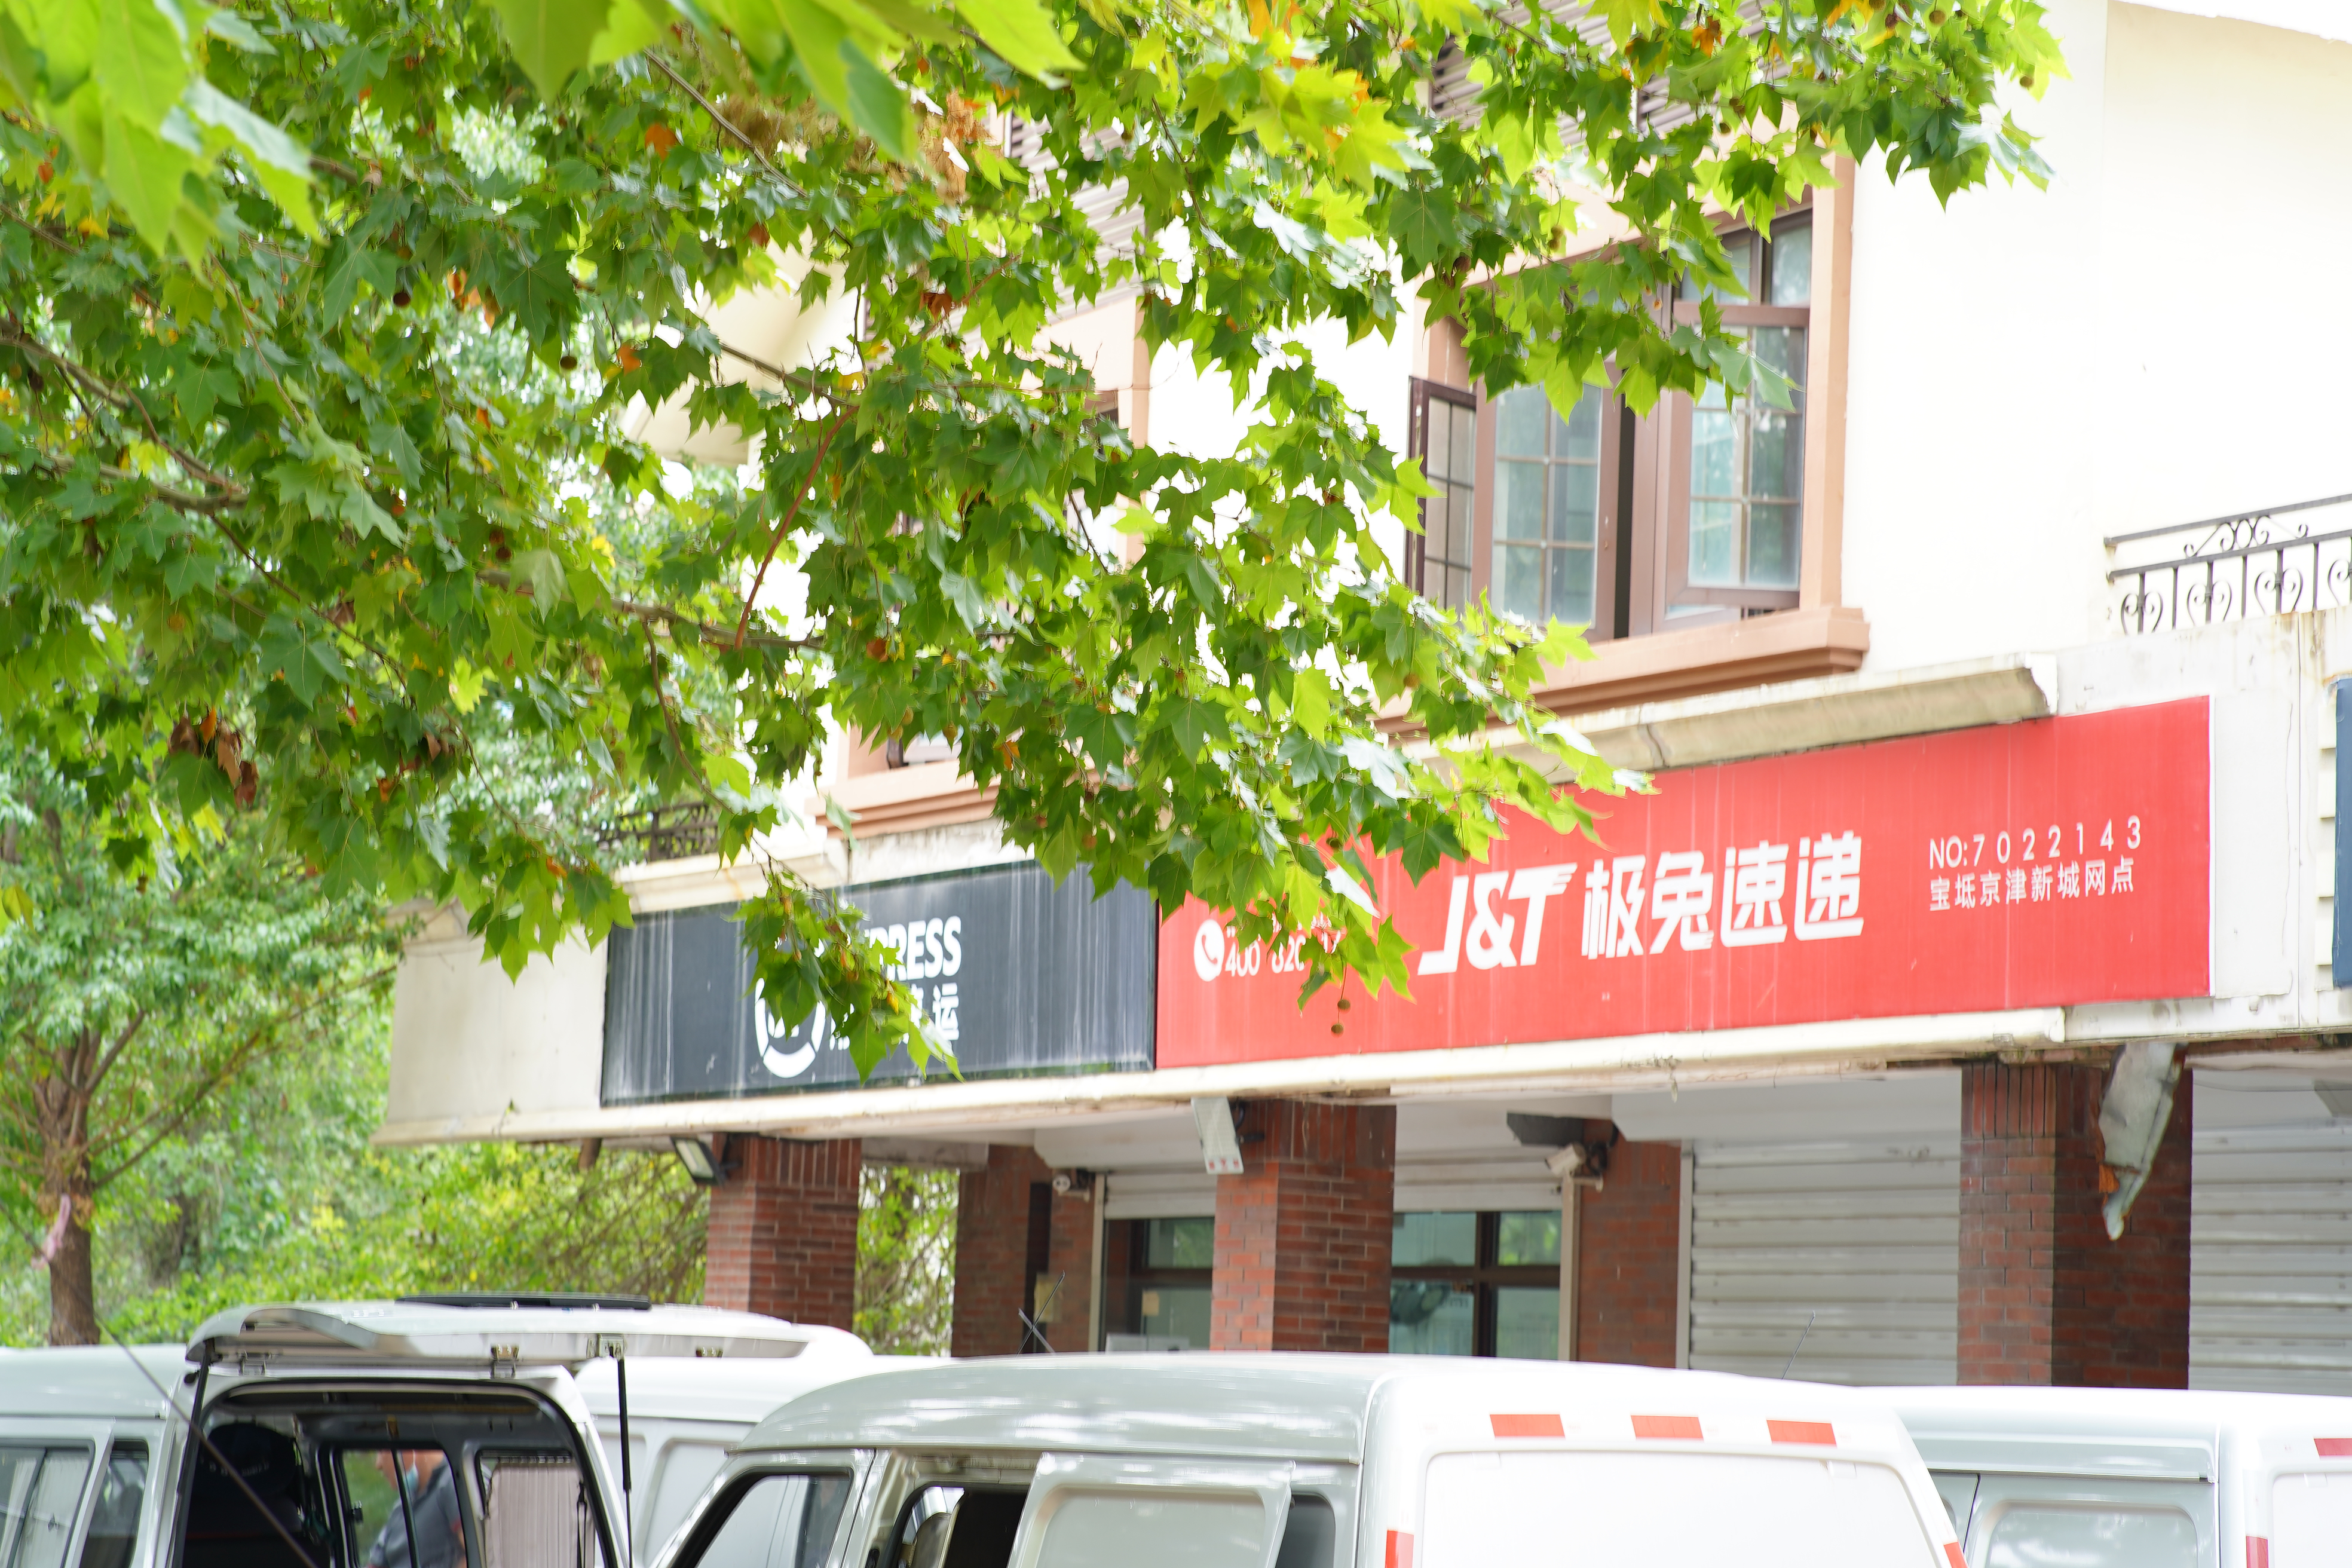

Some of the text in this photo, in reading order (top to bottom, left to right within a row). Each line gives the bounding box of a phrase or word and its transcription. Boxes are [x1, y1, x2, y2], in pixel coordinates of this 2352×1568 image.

[1417, 830, 1864, 976] J&T 极兔速递
[1930, 855, 2134, 911] 宝坻京津新城网点
